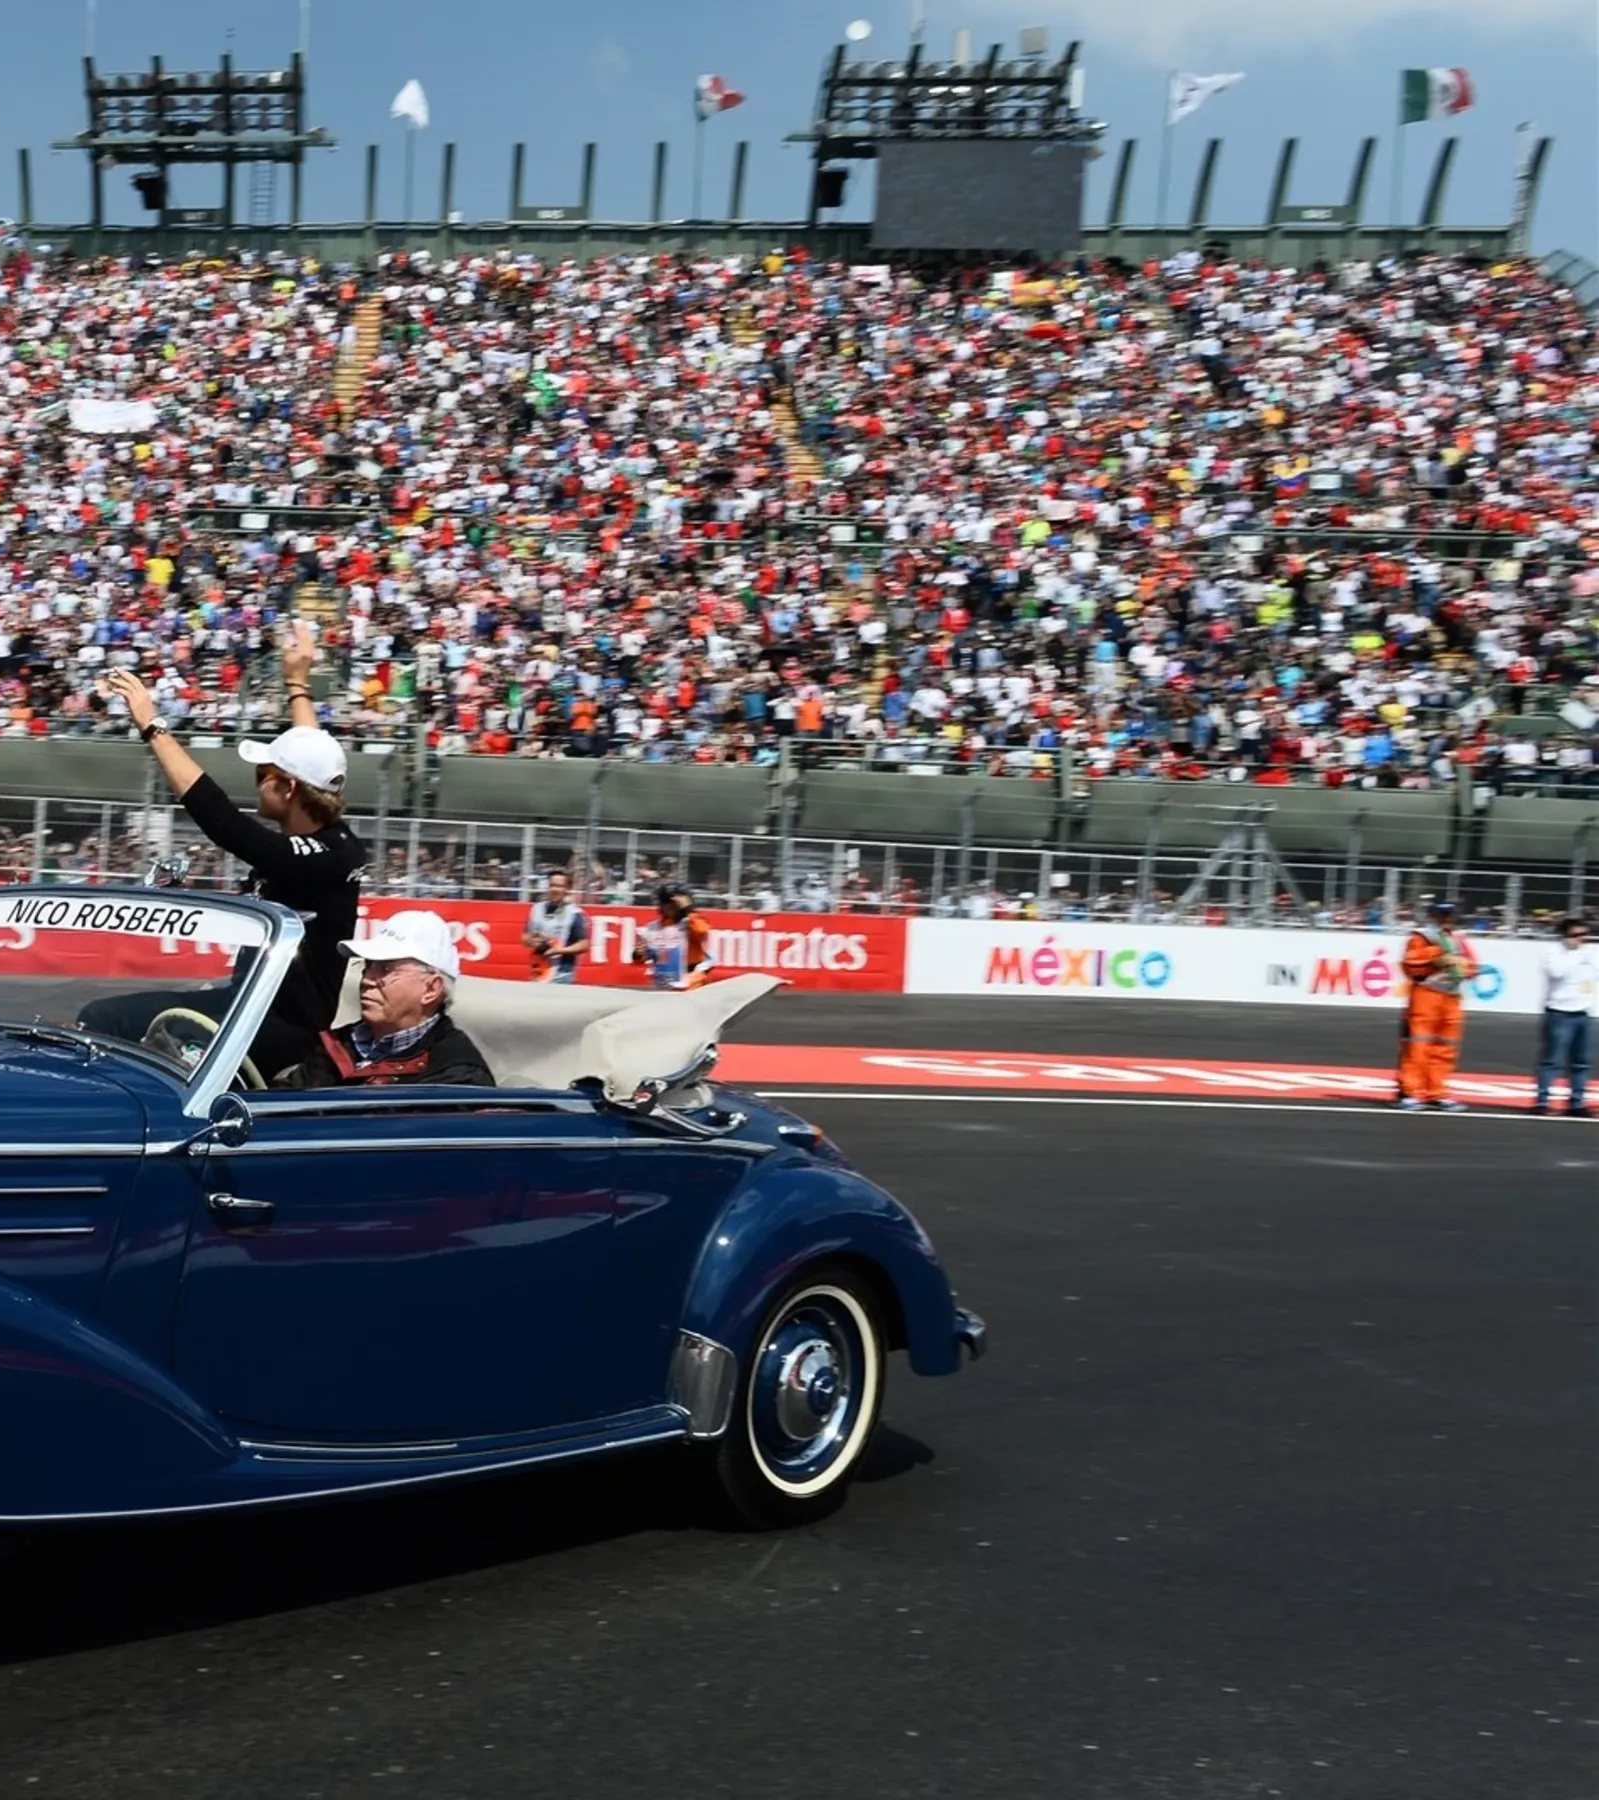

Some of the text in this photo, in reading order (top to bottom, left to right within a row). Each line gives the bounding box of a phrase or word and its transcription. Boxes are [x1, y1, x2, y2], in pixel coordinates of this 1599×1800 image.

[6, 899, 204, 937] NICO ROSBERG
[590, 915, 650, 975] Fl
[704, 919, 869, 971] mirates
